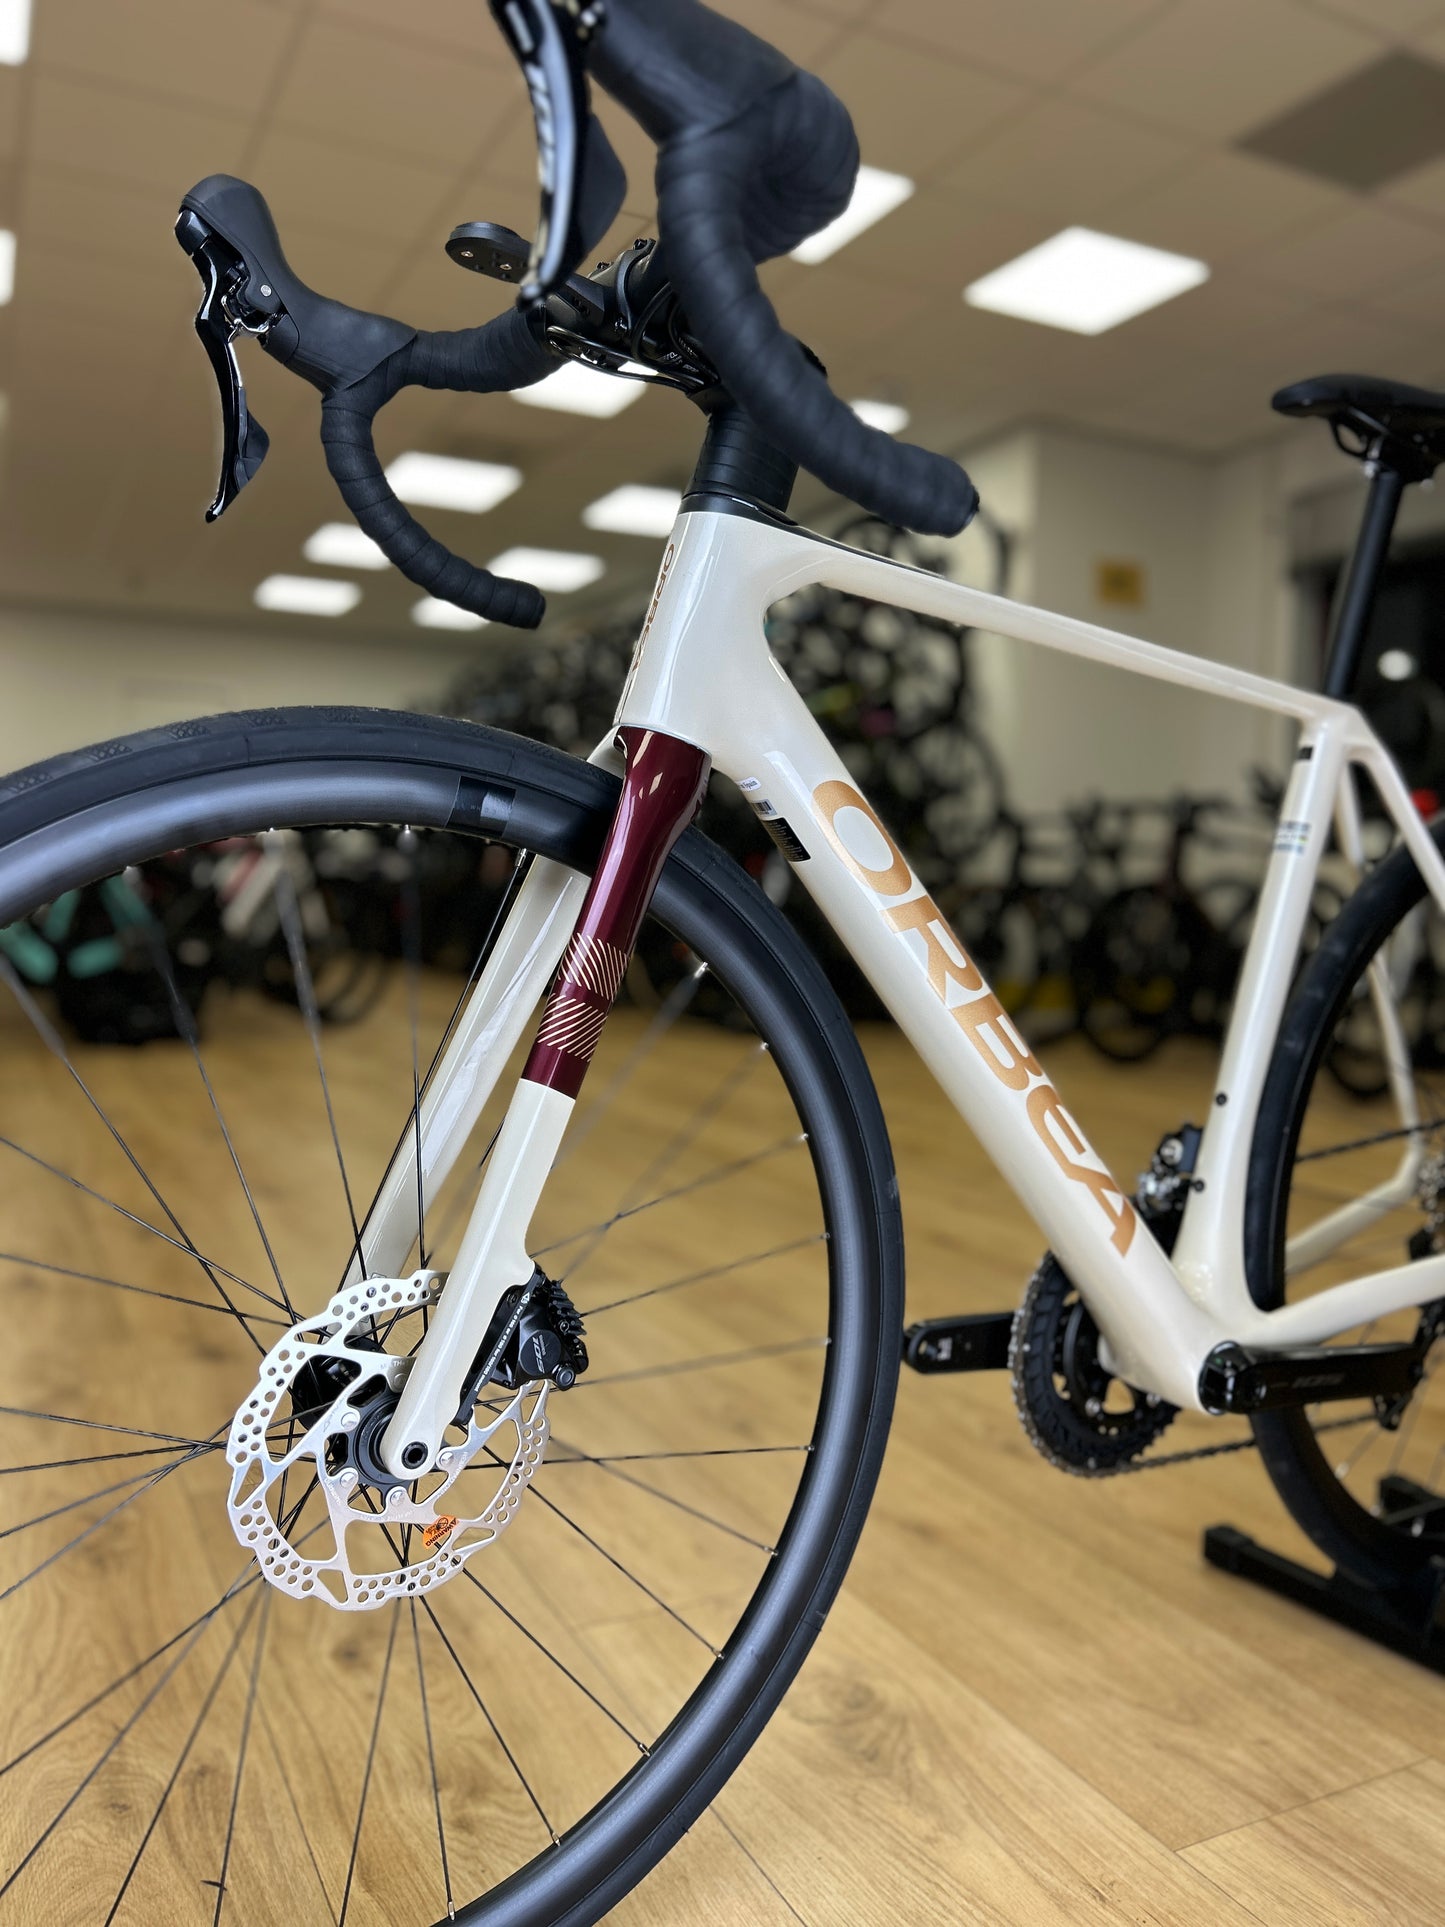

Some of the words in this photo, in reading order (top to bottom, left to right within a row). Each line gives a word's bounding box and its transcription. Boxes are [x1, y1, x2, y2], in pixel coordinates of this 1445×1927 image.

[632, 543, 675, 673] ORBEA
[812, 780, 1137, 1258] ORBEA
[532, 1336, 545, 1374] 105
